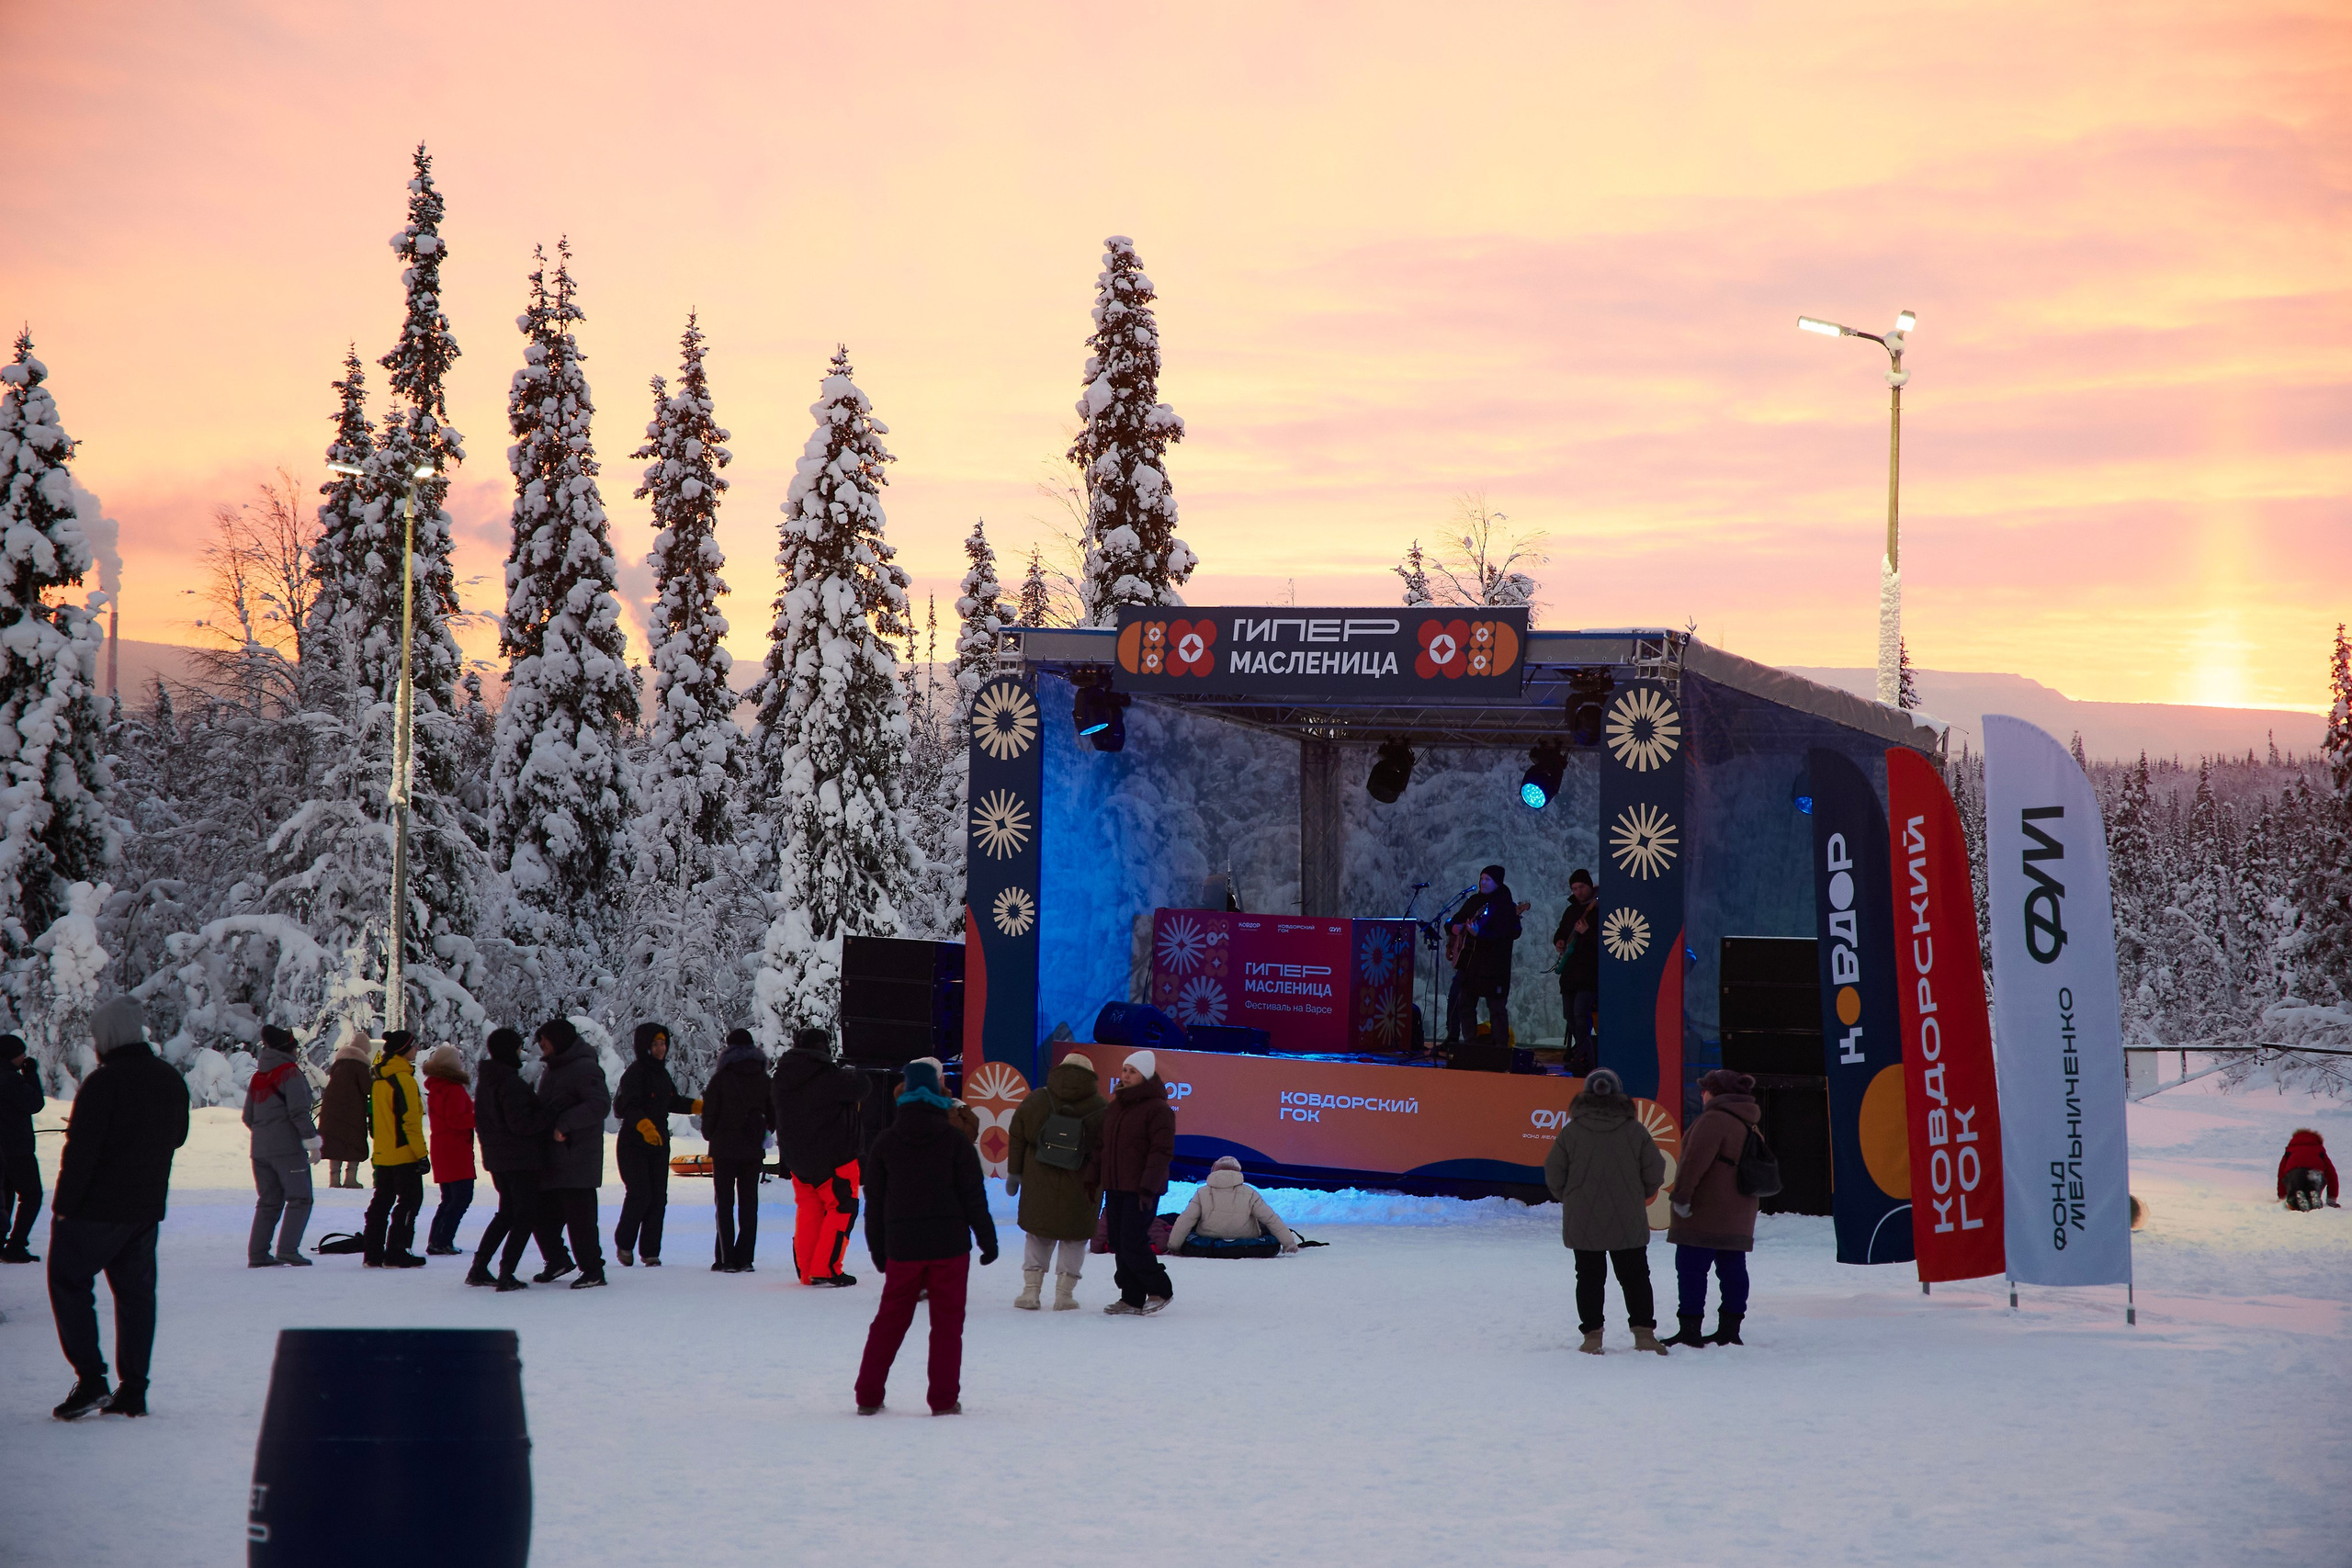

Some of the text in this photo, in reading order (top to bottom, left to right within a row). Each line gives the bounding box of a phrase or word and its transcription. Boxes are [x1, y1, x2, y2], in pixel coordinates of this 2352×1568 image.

[1232, 618, 1400, 642] ГИПЕР
[1229, 650, 1399, 678] МАСЛЕНИЦА
[1245, 962, 1332, 978] ГИПЕР
[1245, 978, 1332, 998] МАСЛЕНИЦА
[1245, 999, 1332, 1015] Фестиваль на Варсе
[1903, 815, 1954, 1234] КОВДОРСКИЙ
[1281, 1090, 1419, 1114] КОВДОРСКИЙ
[2058, 987, 2086, 1232] МЕЛЬНИЧЕНКО
[1280, 1107, 1320, 1122] ГОК
[1954, 1105, 1984, 1231] ГОК
[2051, 1161, 2067, 1251] ФОНД
